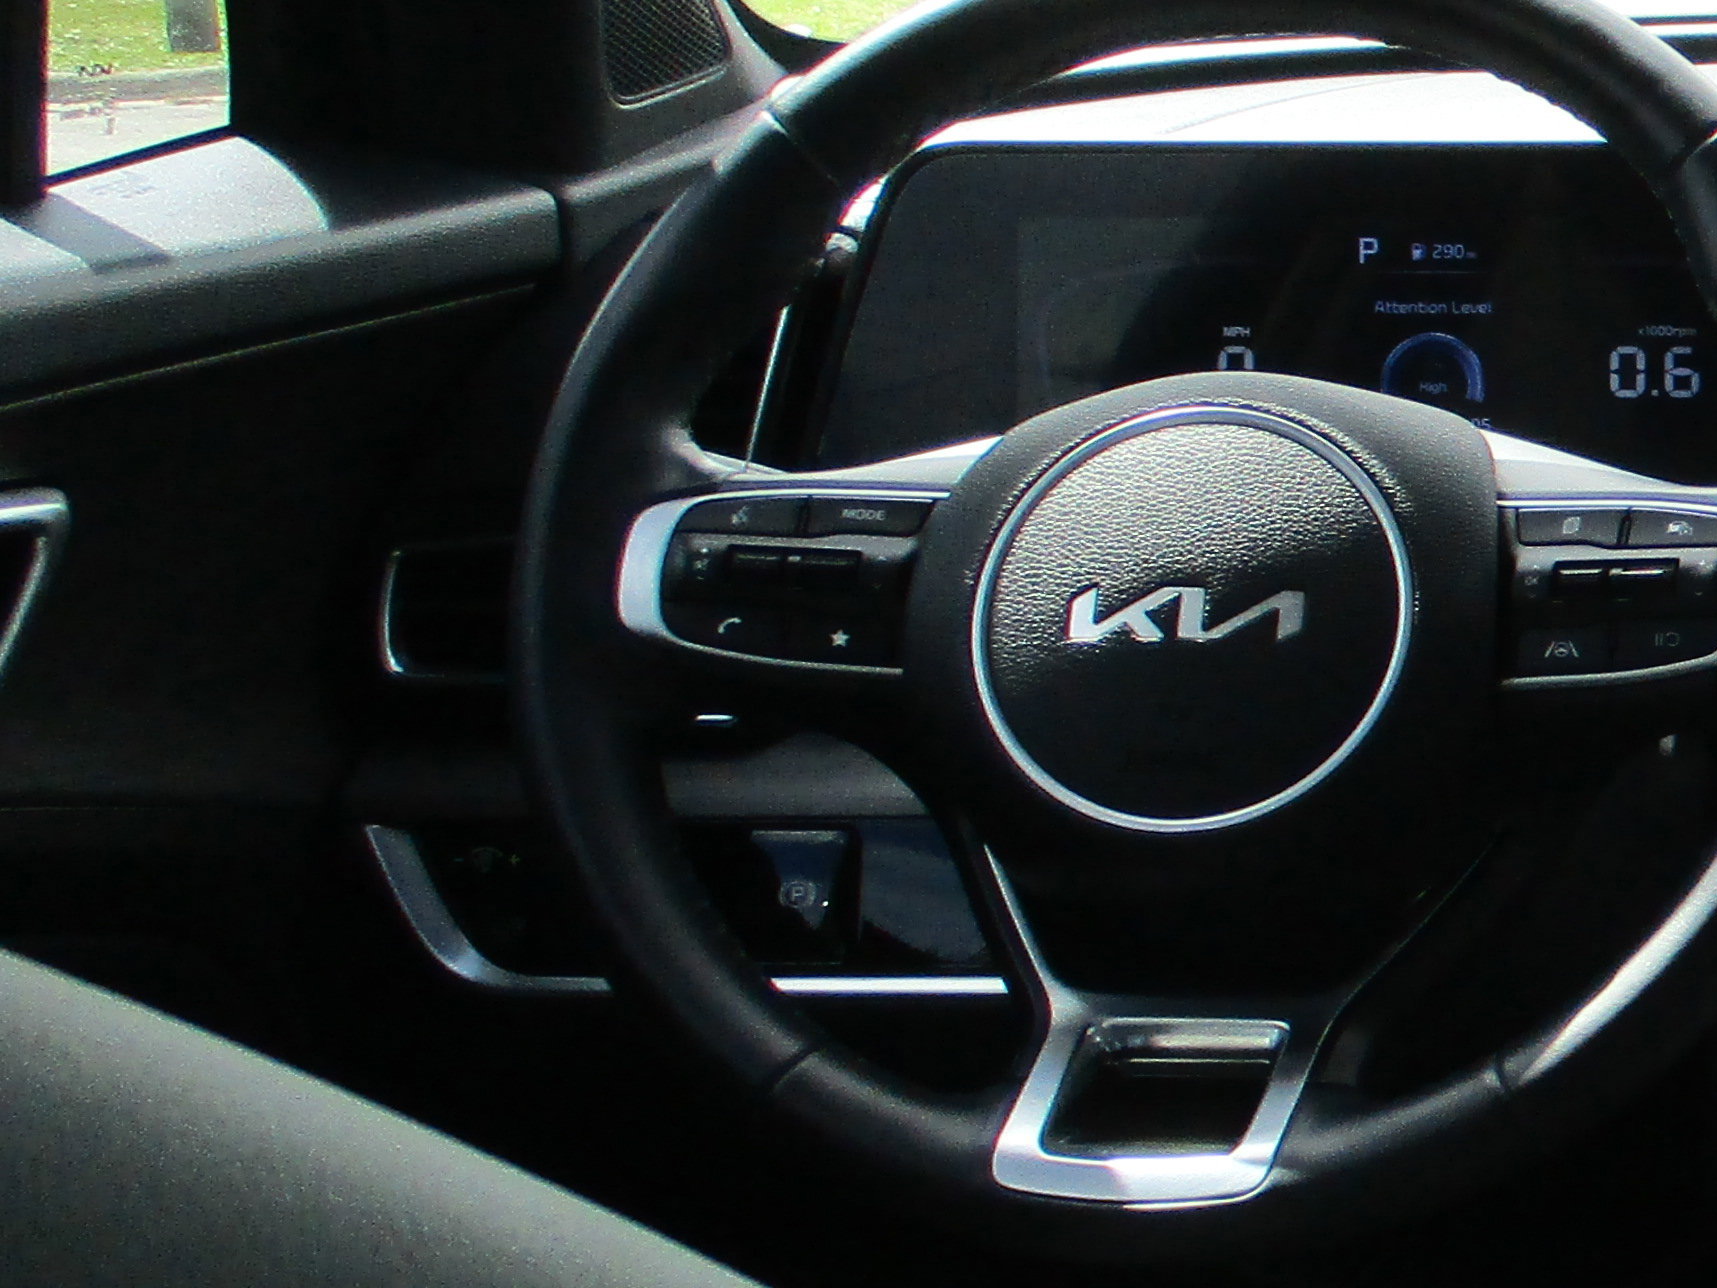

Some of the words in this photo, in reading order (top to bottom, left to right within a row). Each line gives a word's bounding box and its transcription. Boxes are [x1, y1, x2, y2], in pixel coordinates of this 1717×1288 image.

[1358, 237, 1379, 264] P
[1432, 244, 1465, 259] 290
[1374, 300, 1448, 314] Attention
[1451, 300, 1492, 314] Level
[1609, 345, 1700, 399] 0.6
[1419, 381, 1448, 394] High
[840, 508, 887, 521] MODE
[1064, 585, 1306, 646] KIA
